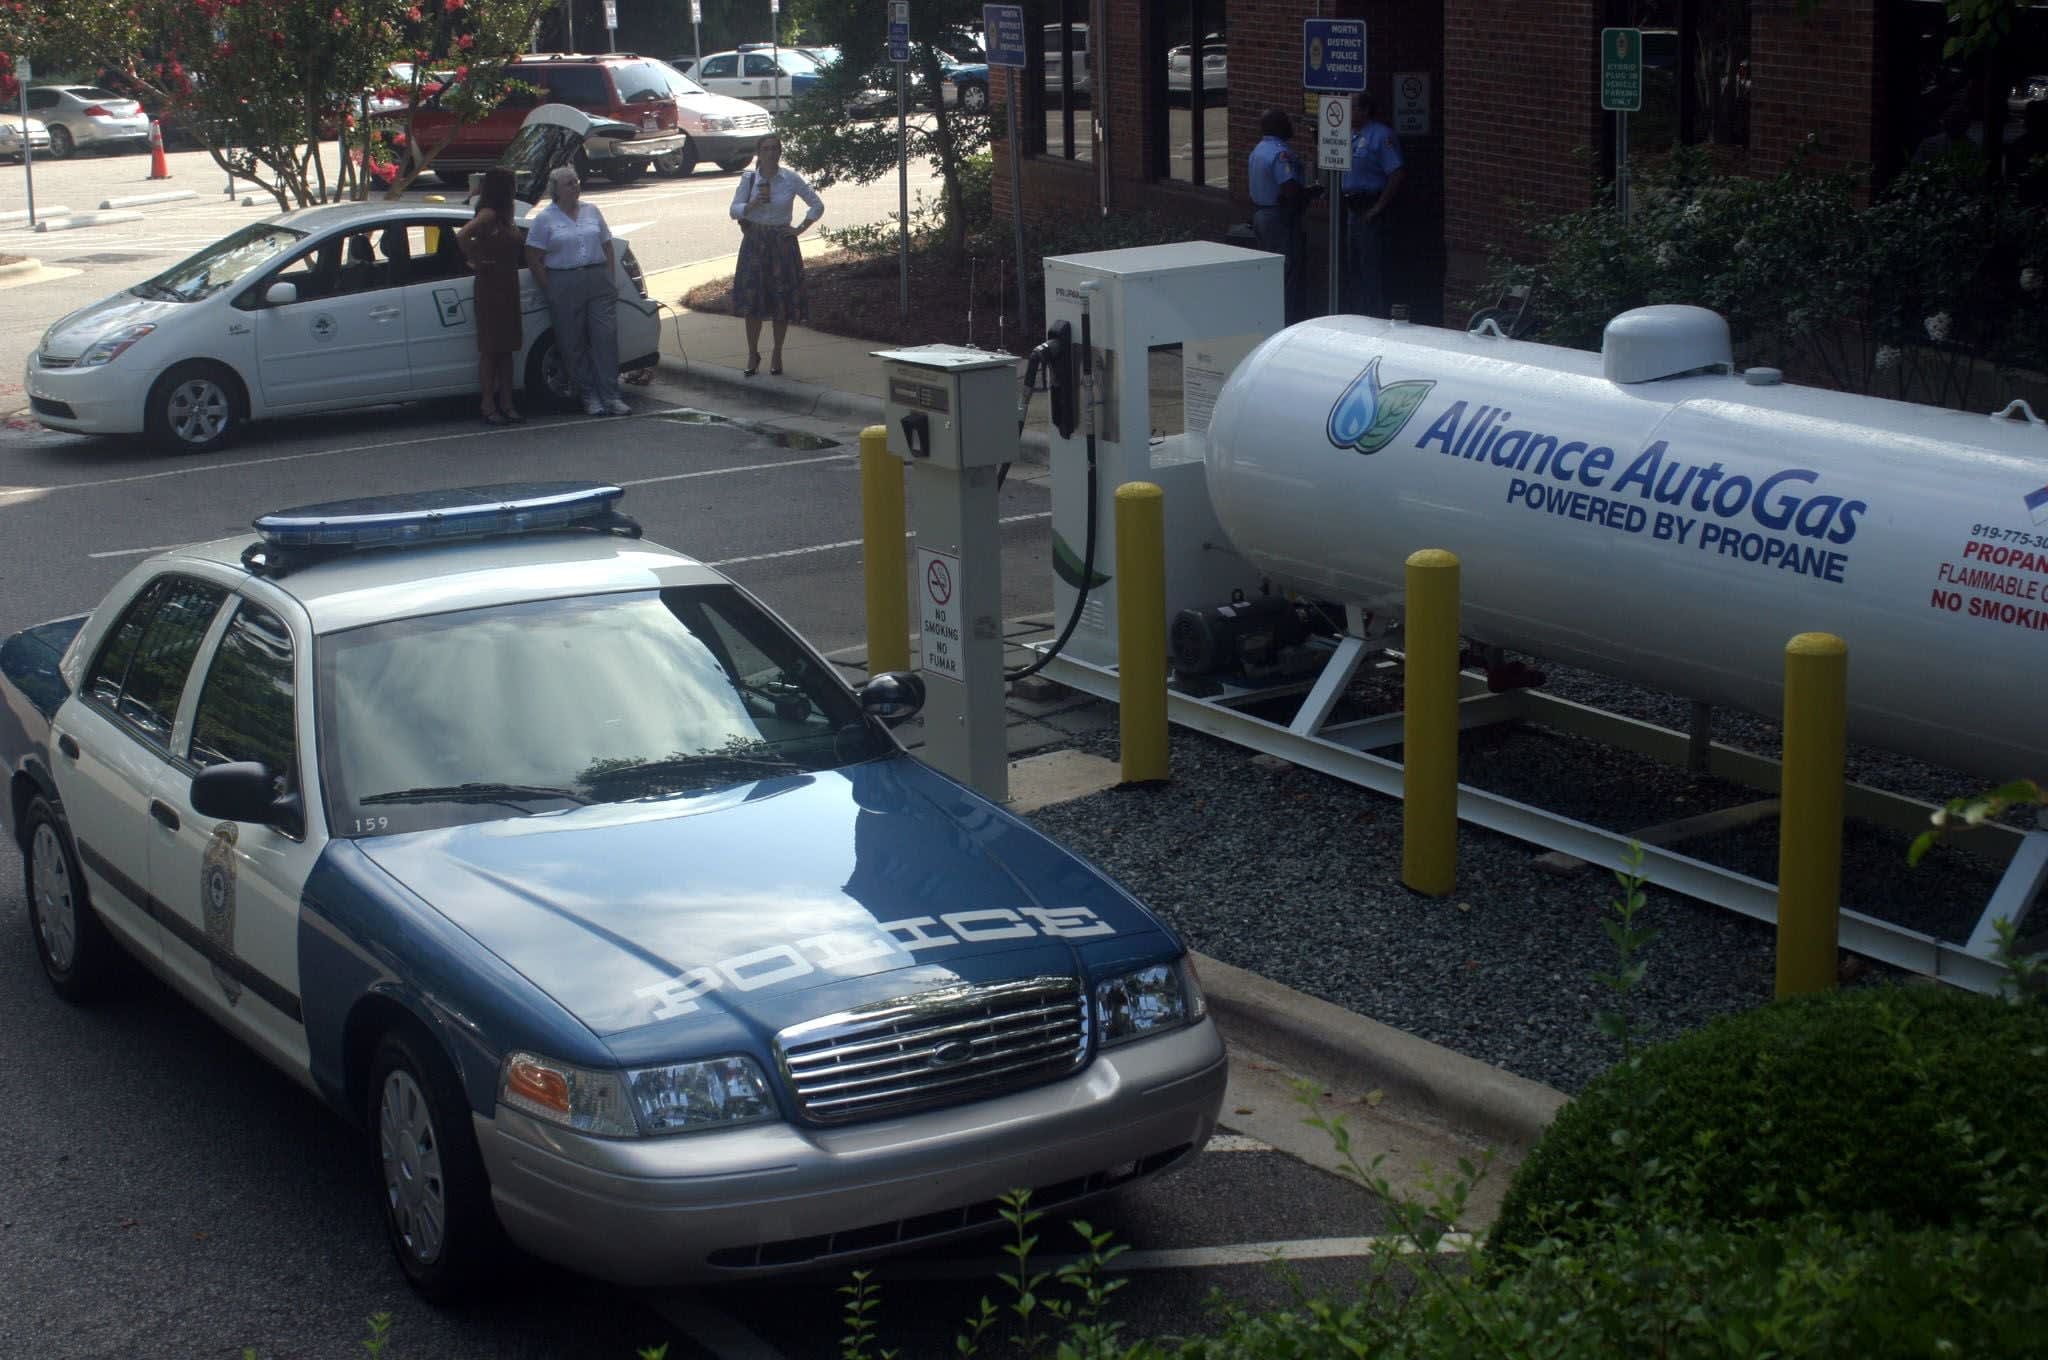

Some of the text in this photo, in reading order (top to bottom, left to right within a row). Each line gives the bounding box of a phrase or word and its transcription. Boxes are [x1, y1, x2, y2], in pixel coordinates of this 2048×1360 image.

[1331, 25, 1358, 33] NORTH
[1327, 38, 1361, 47] DISTRICT
[1331, 51, 1358, 60] POLICE
[1327, 64, 1363, 73] VEHICLES
[1322, 138, 1347, 147] SMOKING
[1415, 400, 1868, 545] Alliance AutoGas
[1507, 478, 1849, 584] POWERED BY PROPANE
[1938, 563, 2039, 601] FLAMMABLE
[1931, 588, 1963, 612] NO
[935, 609, 946, 622] NO
[924, 621, 959, 640] SMOKING
[936, 641, 948, 655] NO
[929, 653, 956, 672] FUMAR
[355, 816, 389, 833] 159
[633, 906, 1117, 1021] POLICE
